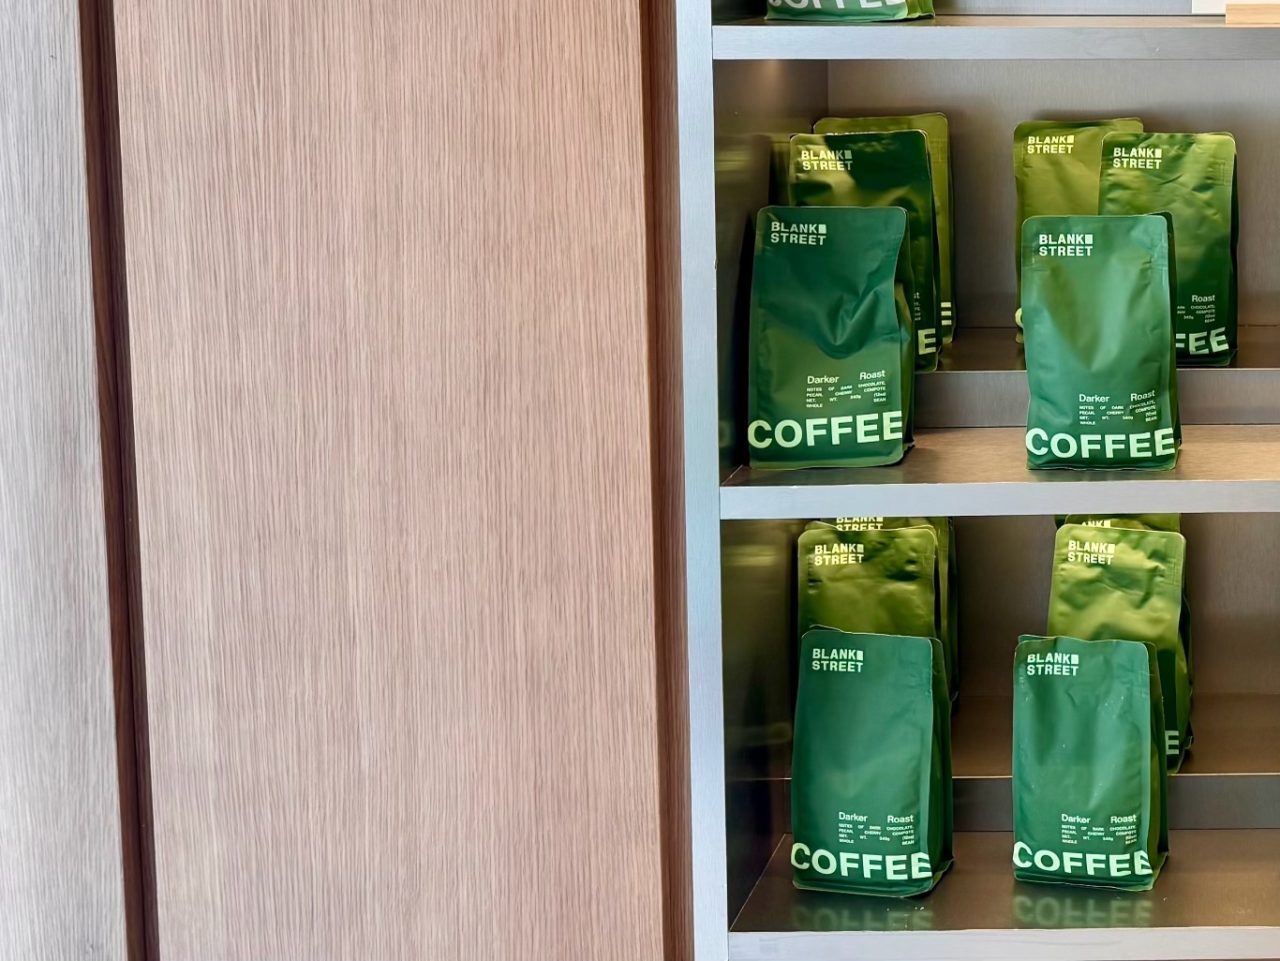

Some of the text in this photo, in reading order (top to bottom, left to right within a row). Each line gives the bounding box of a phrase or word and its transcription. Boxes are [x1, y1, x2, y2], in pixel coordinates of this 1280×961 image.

[1028, 135, 1067, 145] BLANK
[801, 150, 843, 160] BLANK
[1027, 144, 1074, 154] STREET
[1113, 147, 1155, 158] BLANK
[802, 160, 853, 171] STREET
[1113, 158, 1162, 169] STREET
[771, 221, 817, 234] BLANK
[770, 232, 827, 246] STREET
[1039, 234, 1085, 245] BLANK
[1039, 246, 1093, 257] STREET
[1192, 294, 1216, 303] Roast
[807, 370, 886, 385] Darker Roast
[1079, 390, 1156, 403] Darker Roast
[747, 410, 903, 449] COFFEE
[1025, 427, 1176, 459] COFFEE
[814, 543, 856, 554] BLANK
[1068, 540, 1107, 553] BLANK
[814, 554, 864, 566] STREET
[1068, 552, 1114, 565] STREET
[812, 648, 856, 660] BLANK
[1027, 652, 1071, 664] BLANK
[811, 661, 863, 672] STREET
[1027, 664, 1079, 676] STREET
[838, 812, 914, 823] Darker Roast
[1061, 814, 1137, 824] Darker Roast
[790, 842, 933, 880] COFFEE
[1013, 841, 1153, 877] COFFEE
